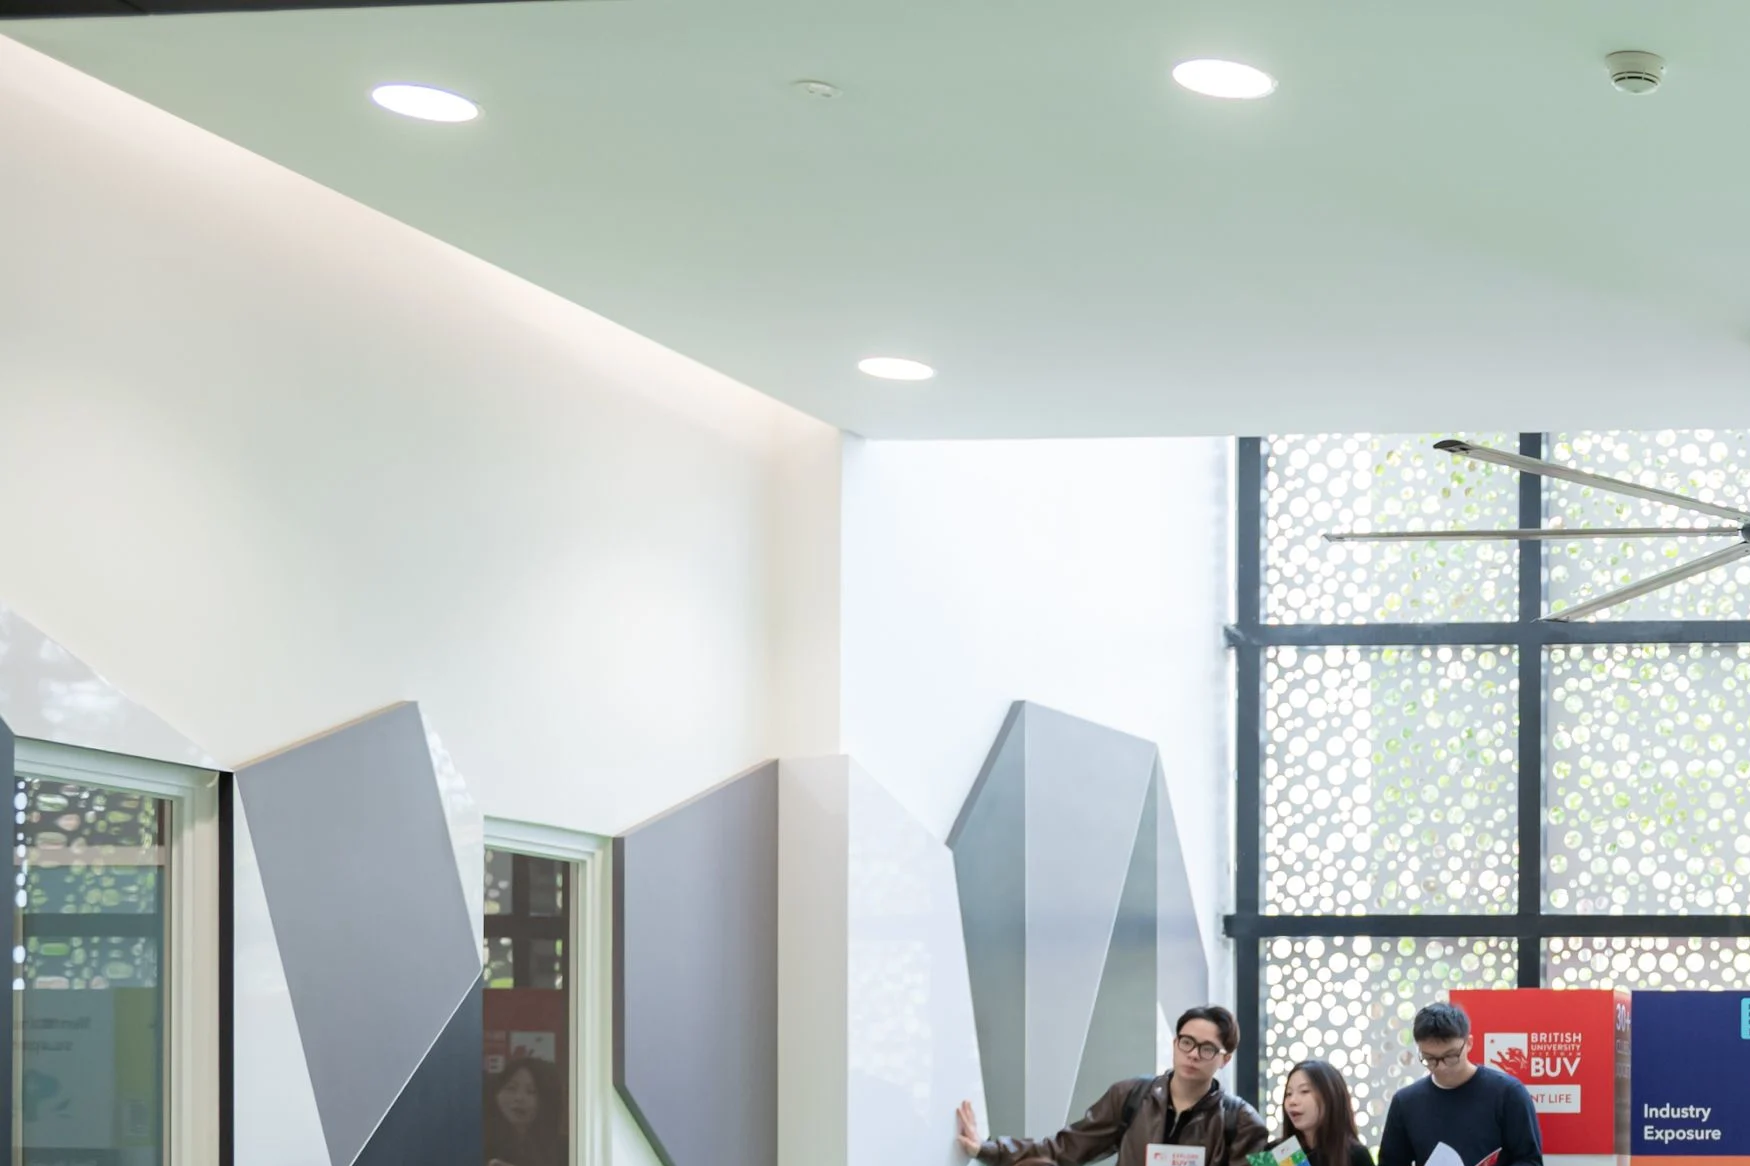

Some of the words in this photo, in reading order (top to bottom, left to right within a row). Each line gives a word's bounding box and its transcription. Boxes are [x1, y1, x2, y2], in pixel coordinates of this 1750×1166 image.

[1530, 1032, 1582, 1043] BRITISH
[1530, 1057, 1581, 1077] BUV
[1549, 1094, 1572, 1103] LIFE
[1643, 1103, 1711, 1122] Industry
[1643, 1125, 1722, 1144] Exposure
